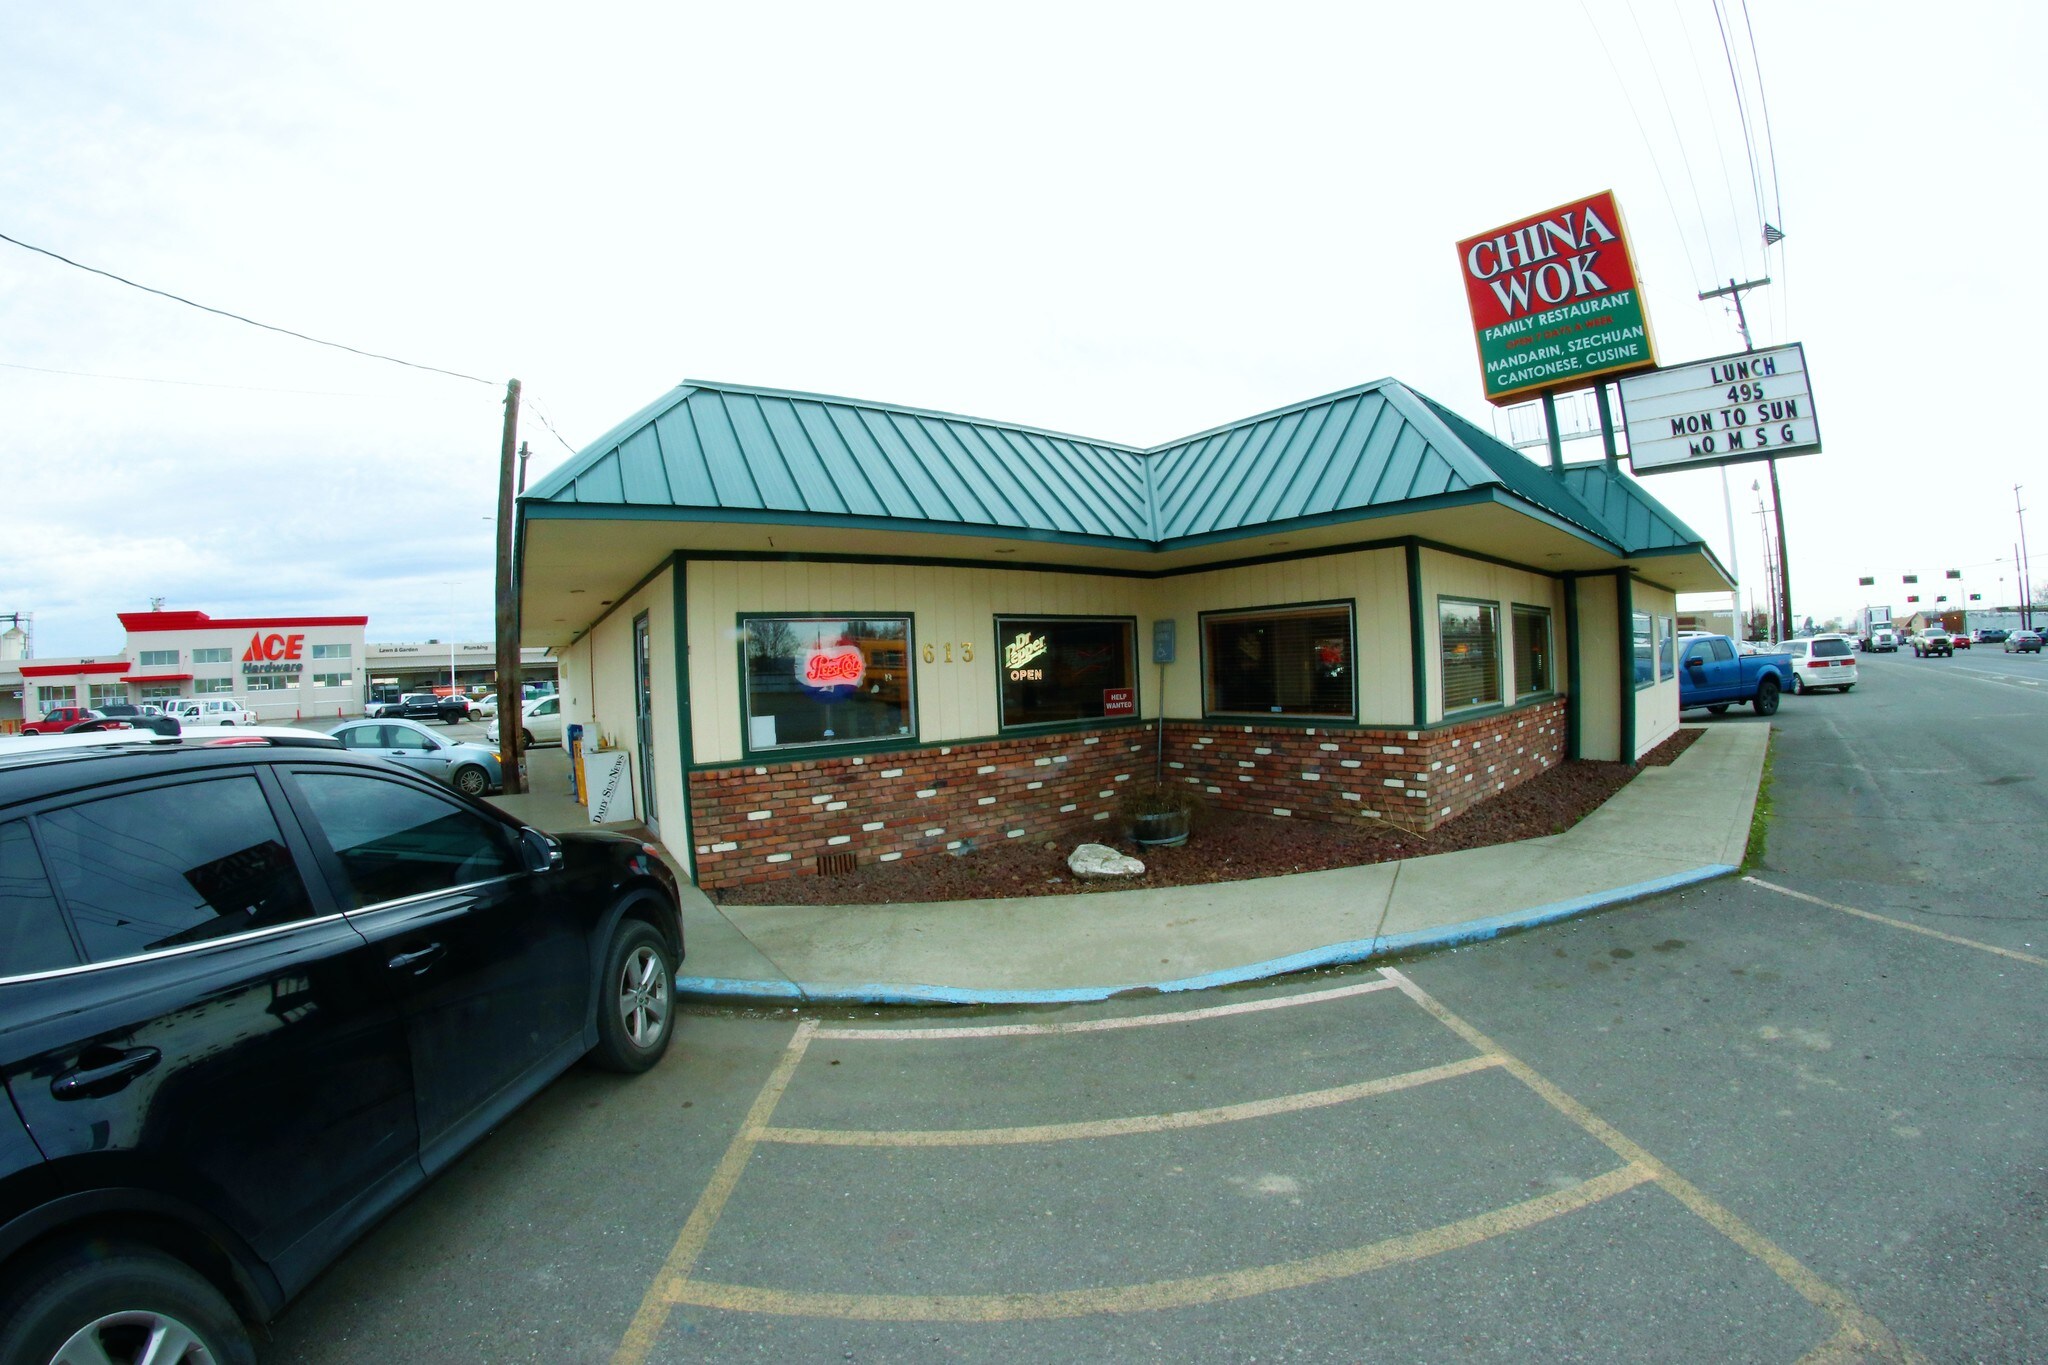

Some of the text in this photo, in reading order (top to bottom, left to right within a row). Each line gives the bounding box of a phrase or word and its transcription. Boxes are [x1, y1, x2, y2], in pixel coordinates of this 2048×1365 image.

[1467, 206, 1616, 279] CHINA
[1490, 251, 1608, 316] WOK
[1485, 292, 1630, 341] FAMILY RESTAURANT
[1506, 336, 1533, 349] OPEN
[1544, 325, 1572, 339] DAYS
[1575, 322, 1582, 331] A
[1585, 316, 1613, 328] WEEK
[1487, 325, 1644, 373] MANDARIN, SZECHUAN
[1497, 343, 1638, 386] CANTONESE, CUSINE
[1710, 356, 1776, 384] LUNCH
[1727, 382, 1764, 402] 495
[1671, 399, 1798, 436] MON TO SUN
[242, 631, 305, 661] ACE
[923, 642, 974, 664] 613
[1005, 635, 1046, 668] Pepper
[1015, 632, 1031, 650] Dr
[242, 662, 303, 674] Hardware
[1010, 669, 1042, 681] OPEN
[1106, 701, 1132, 710] WANTED
[1111, 693, 1127, 701] HELP
[593, 799, 608, 824] DAILY
[602, 780, 615, 798] SUN
[609, 754, 624, 779] NEWS
